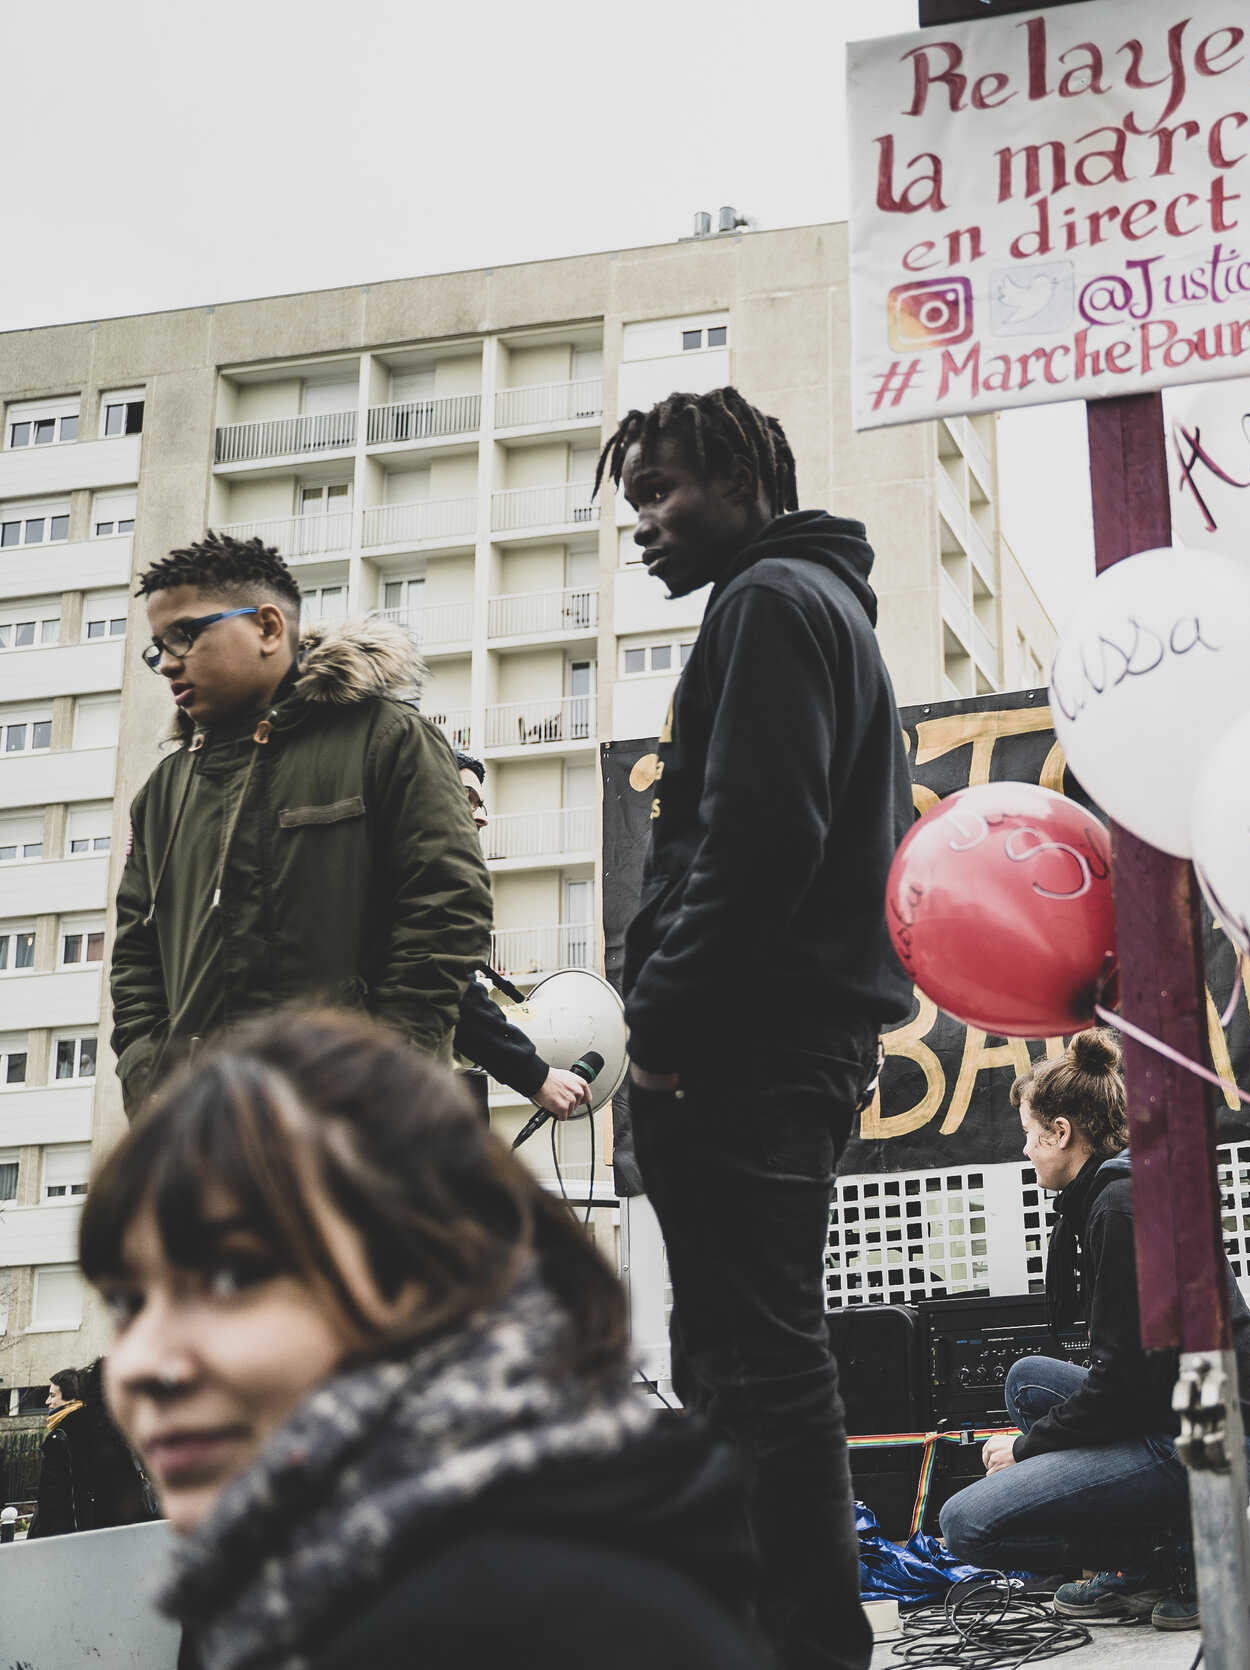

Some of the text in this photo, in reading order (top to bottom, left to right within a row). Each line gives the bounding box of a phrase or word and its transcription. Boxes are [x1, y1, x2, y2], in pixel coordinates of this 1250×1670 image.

[873, 134, 949, 214] la
[902, 221, 984, 272] en
[1010, 179, 1240, 260] direct
